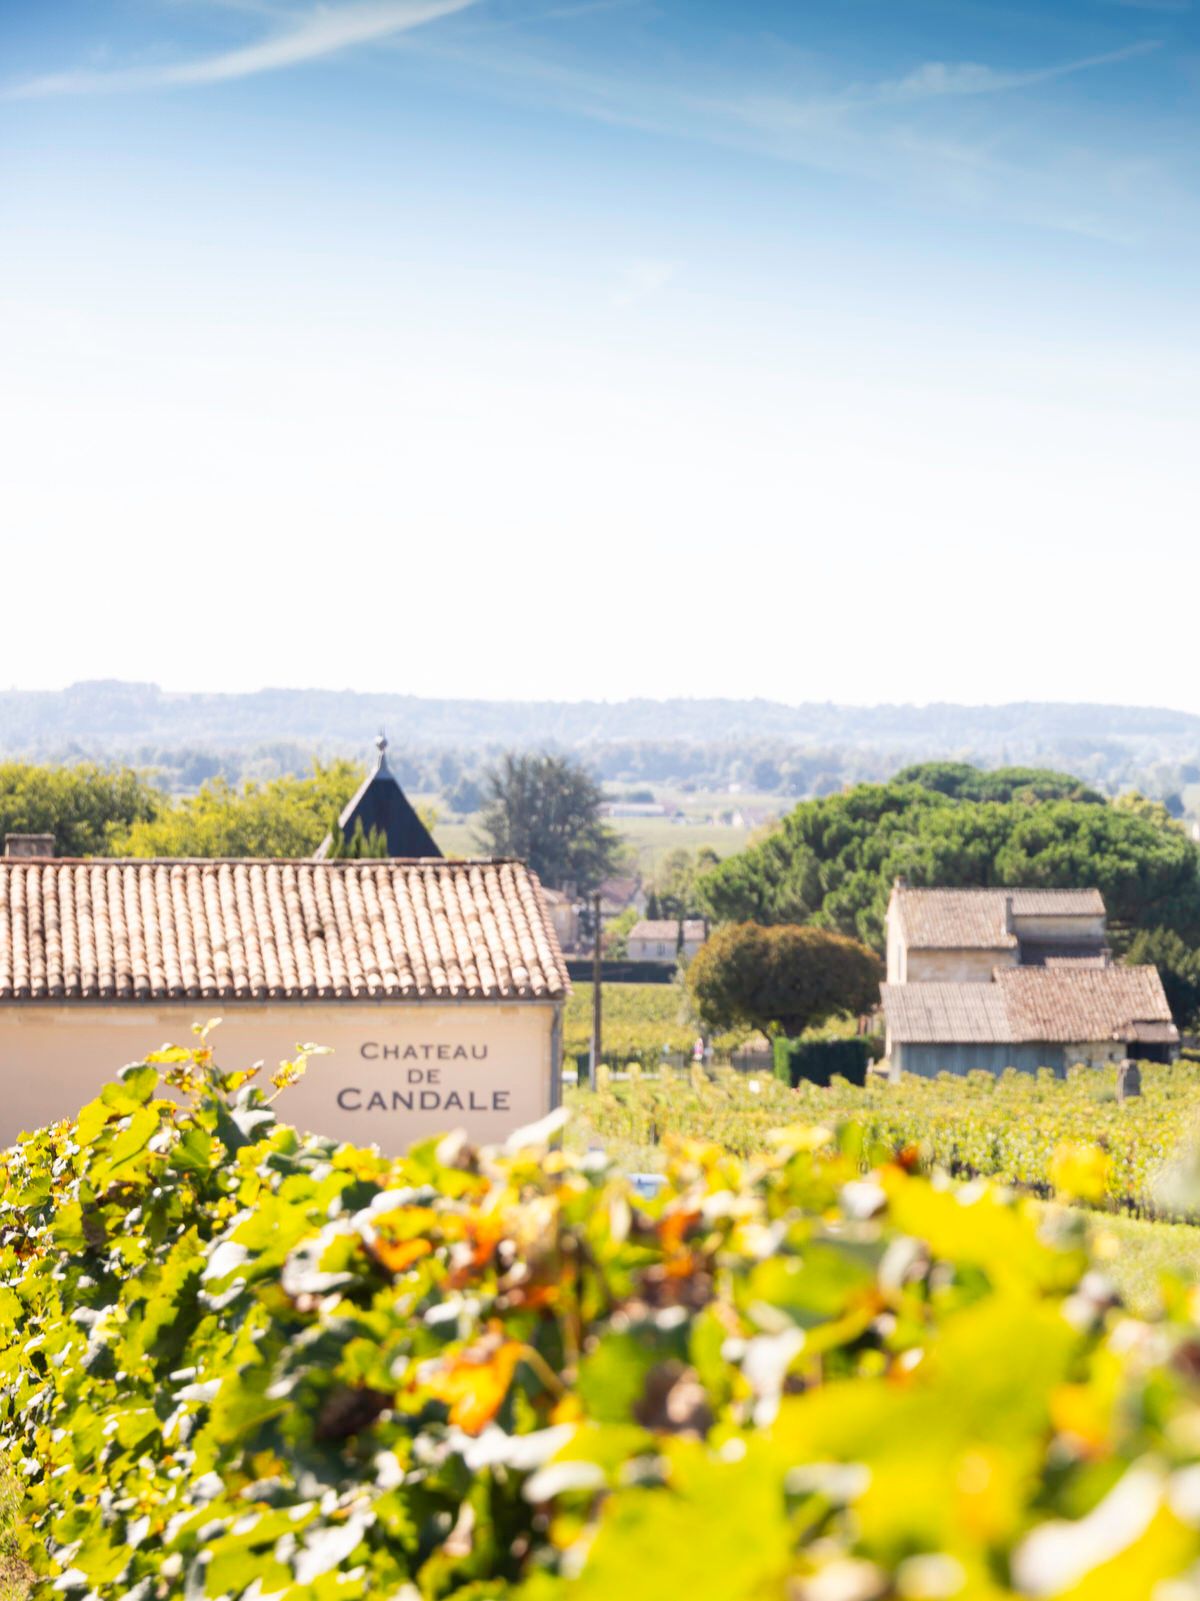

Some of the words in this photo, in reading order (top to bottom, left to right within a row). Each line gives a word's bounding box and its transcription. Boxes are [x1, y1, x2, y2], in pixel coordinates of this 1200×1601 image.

[360, 1042, 488, 1060] CHATEAU
[407, 1069, 440, 1084] DE
[336, 1087, 511, 1111] CANDALE
